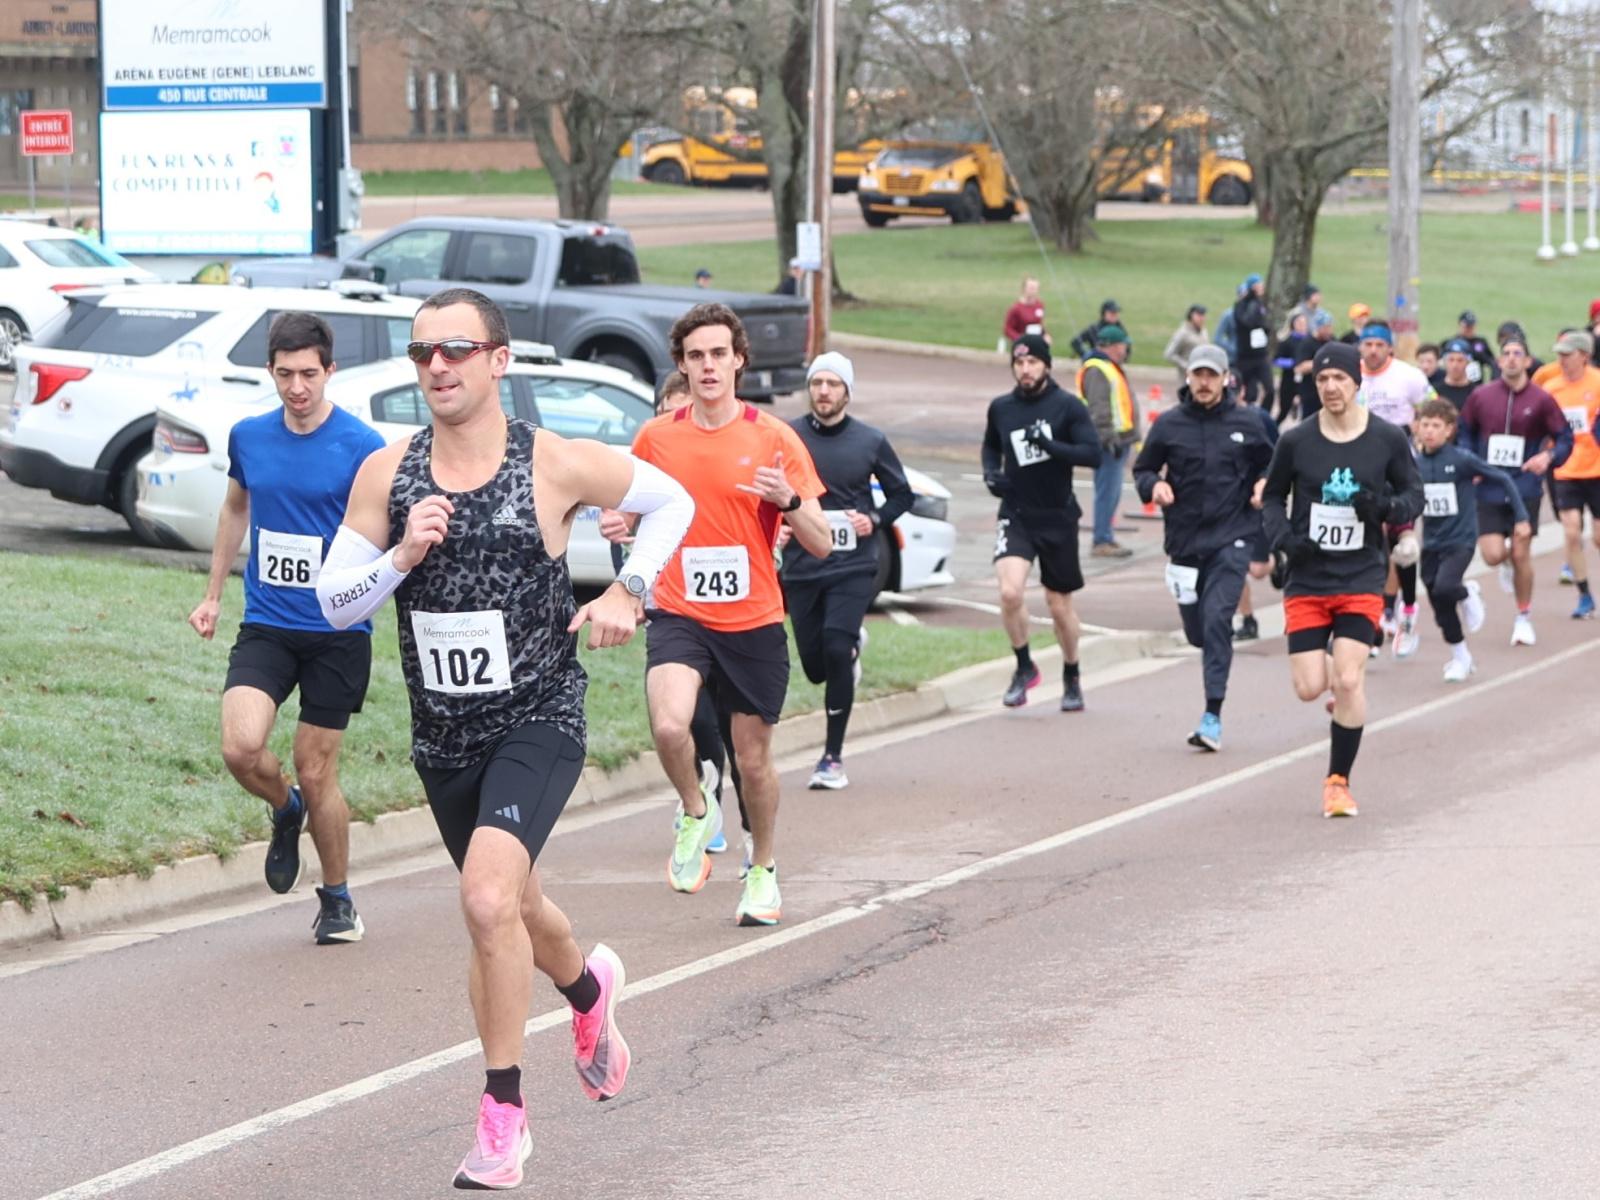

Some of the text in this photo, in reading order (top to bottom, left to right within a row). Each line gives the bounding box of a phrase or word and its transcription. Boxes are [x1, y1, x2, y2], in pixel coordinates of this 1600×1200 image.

[152, 21, 272, 45] Memramcook
[212, 66, 254, 81] (GENE)
[258, 65, 316, 78] LEBLANC
[184, 86, 207, 102] RUE
[209, 86, 269, 102] CENTRALE
[224, 153, 234, 168] &
[113, 177, 243, 192] COMPETITIVE
[492, 517, 523, 527] adidas
[1318, 524, 1355, 546] 207
[267, 554, 311, 584] 266
[694, 570, 739, 597] 243
[328, 579, 372, 611] TERREX
[423, 626, 491, 639] Memramcook
[429, 646, 494, 687] 102
